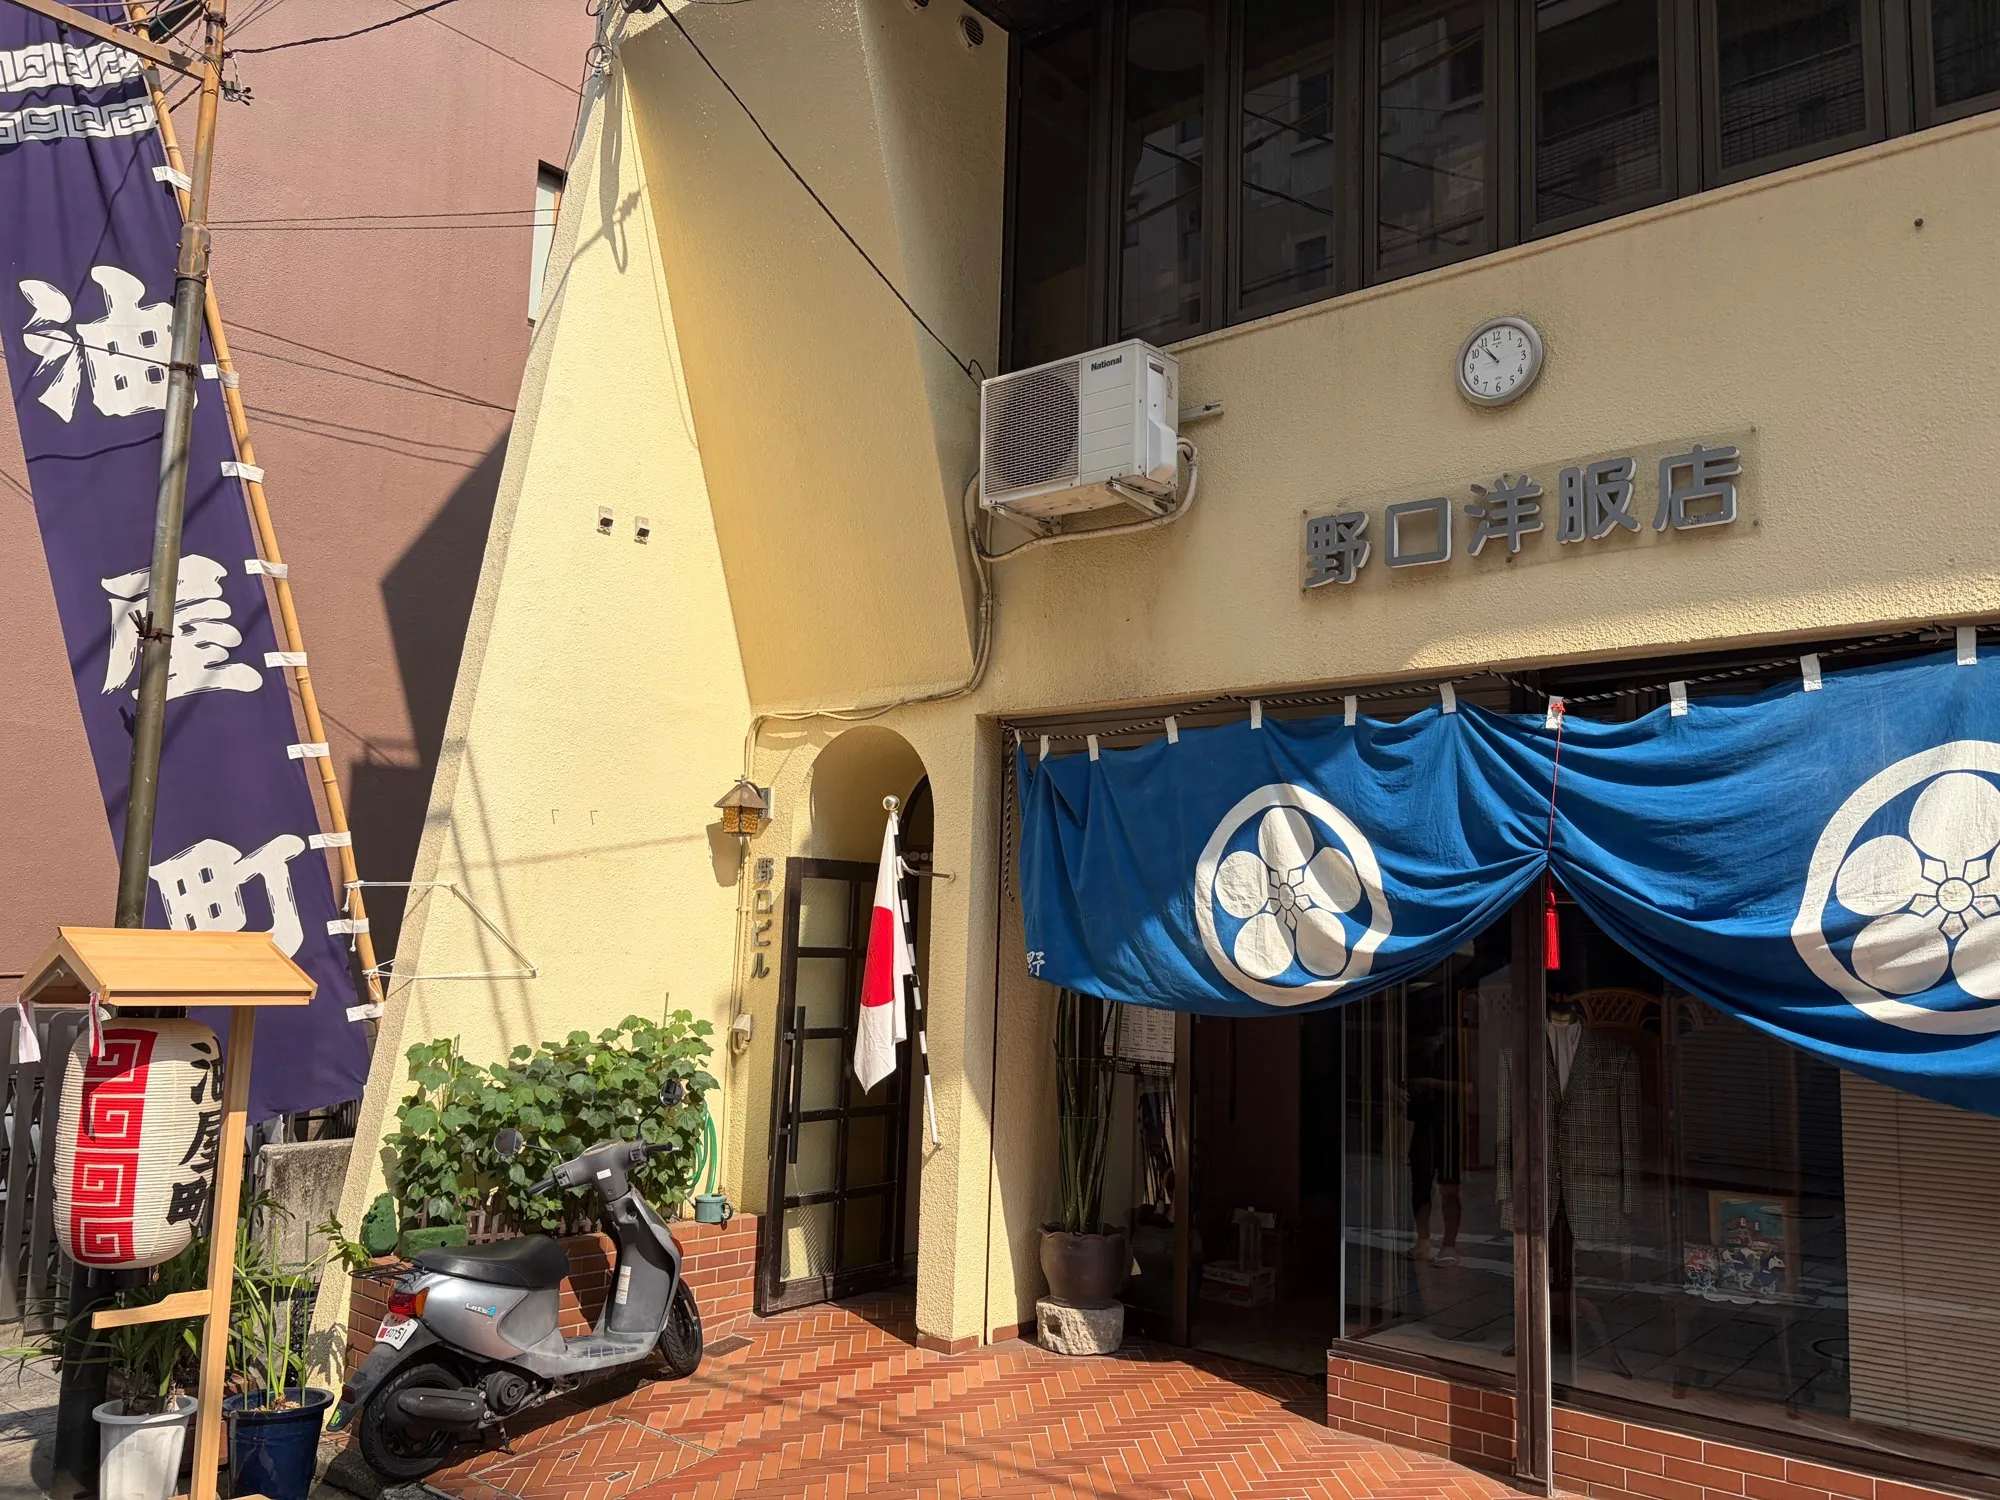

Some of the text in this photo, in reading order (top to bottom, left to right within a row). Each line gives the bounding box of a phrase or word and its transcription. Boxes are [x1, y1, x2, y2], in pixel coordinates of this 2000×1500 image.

[1493, 331, 1501, 341] 12
[1508, 331, 1512, 341] 1
[1481, 338, 1488, 348] 11
[1517, 338, 1523, 348] 2
[1472, 349, 1480, 359] 10
[1521, 350, 1527, 360] 3
[1091, 355, 1122, 371] National
[1469, 363, 1475, 373] 9
[1517, 364, 1523, 374] 4
[1473, 375, 1479, 385] 8
[1509, 375, 1515, 385] 5
[1483, 381, 1488, 392] 7
[1495, 382, 1501, 392] 6
[1305, 444, 1743, 588] 野口洋服店
[20, 264, 306, 958] 油屋町
[751, 858, 774, 979] 野口ビル
